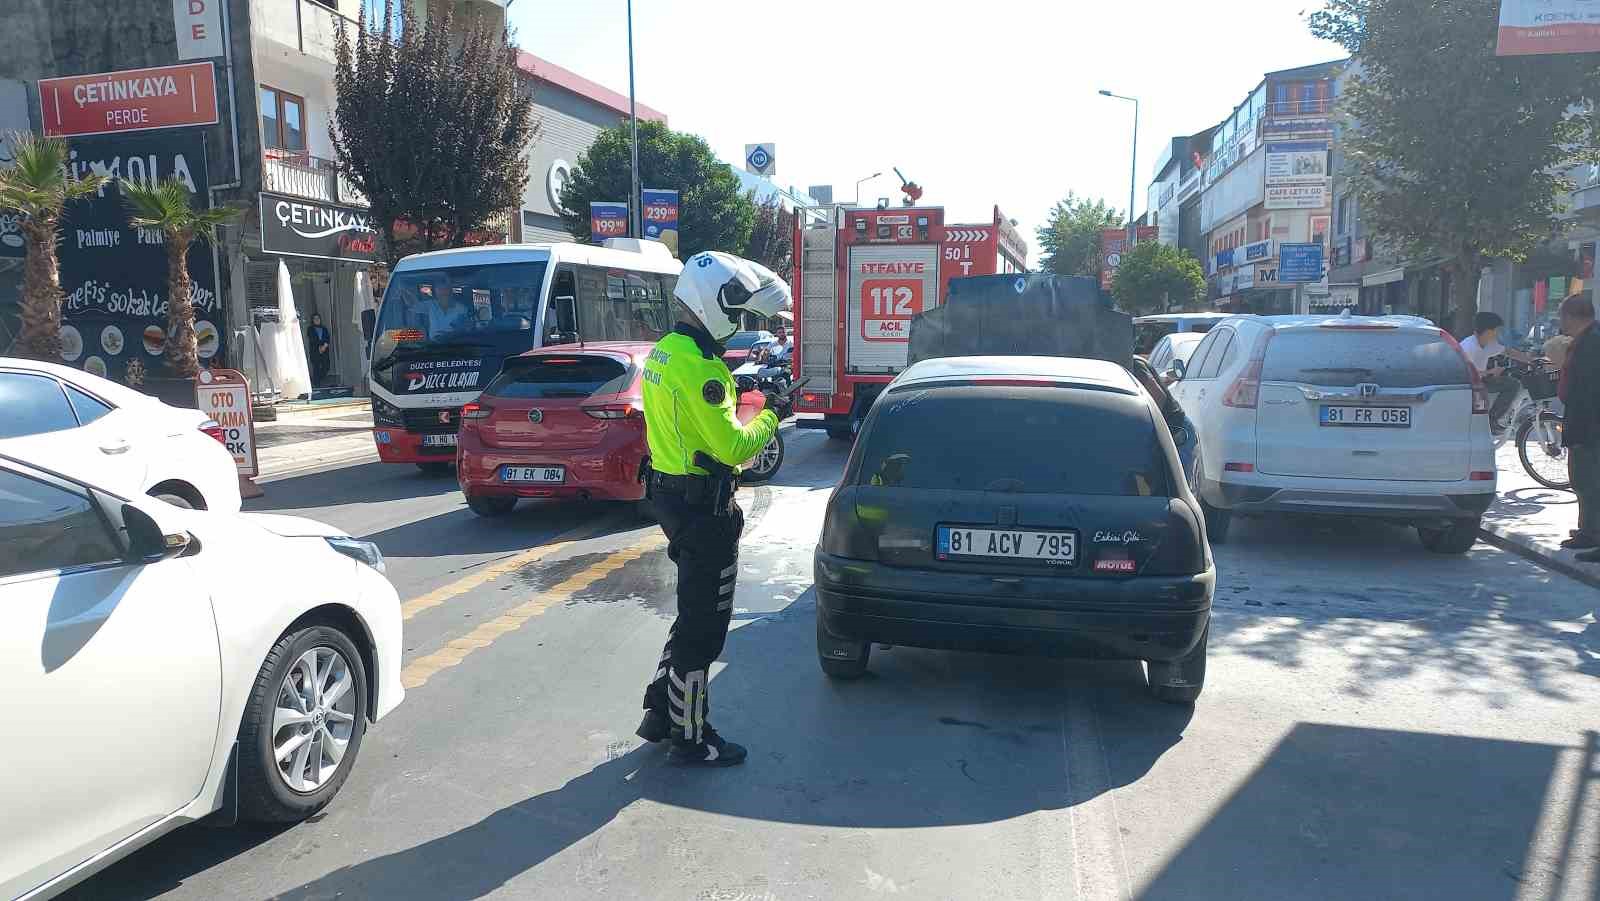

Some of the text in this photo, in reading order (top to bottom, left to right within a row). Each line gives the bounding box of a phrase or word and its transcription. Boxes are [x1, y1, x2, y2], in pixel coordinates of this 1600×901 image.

[73, 76, 177, 108] ÇETİNKAYA
[106, 108, 148, 125] PERDE
[77, 228, 120, 248] Palmiye
[945, 247, 961, 260] 50
[871, 286, 913, 315] 112
[212, 392, 234, 408] OTO
[1329, 408, 1408, 423] 81 FR 058
[222, 428, 241, 441] TO
[507, 468, 561, 481] 81 EK 084
[951, 531, 1072, 557] 81 ACV 795
[1096, 561, 1136, 570] MOTUL
